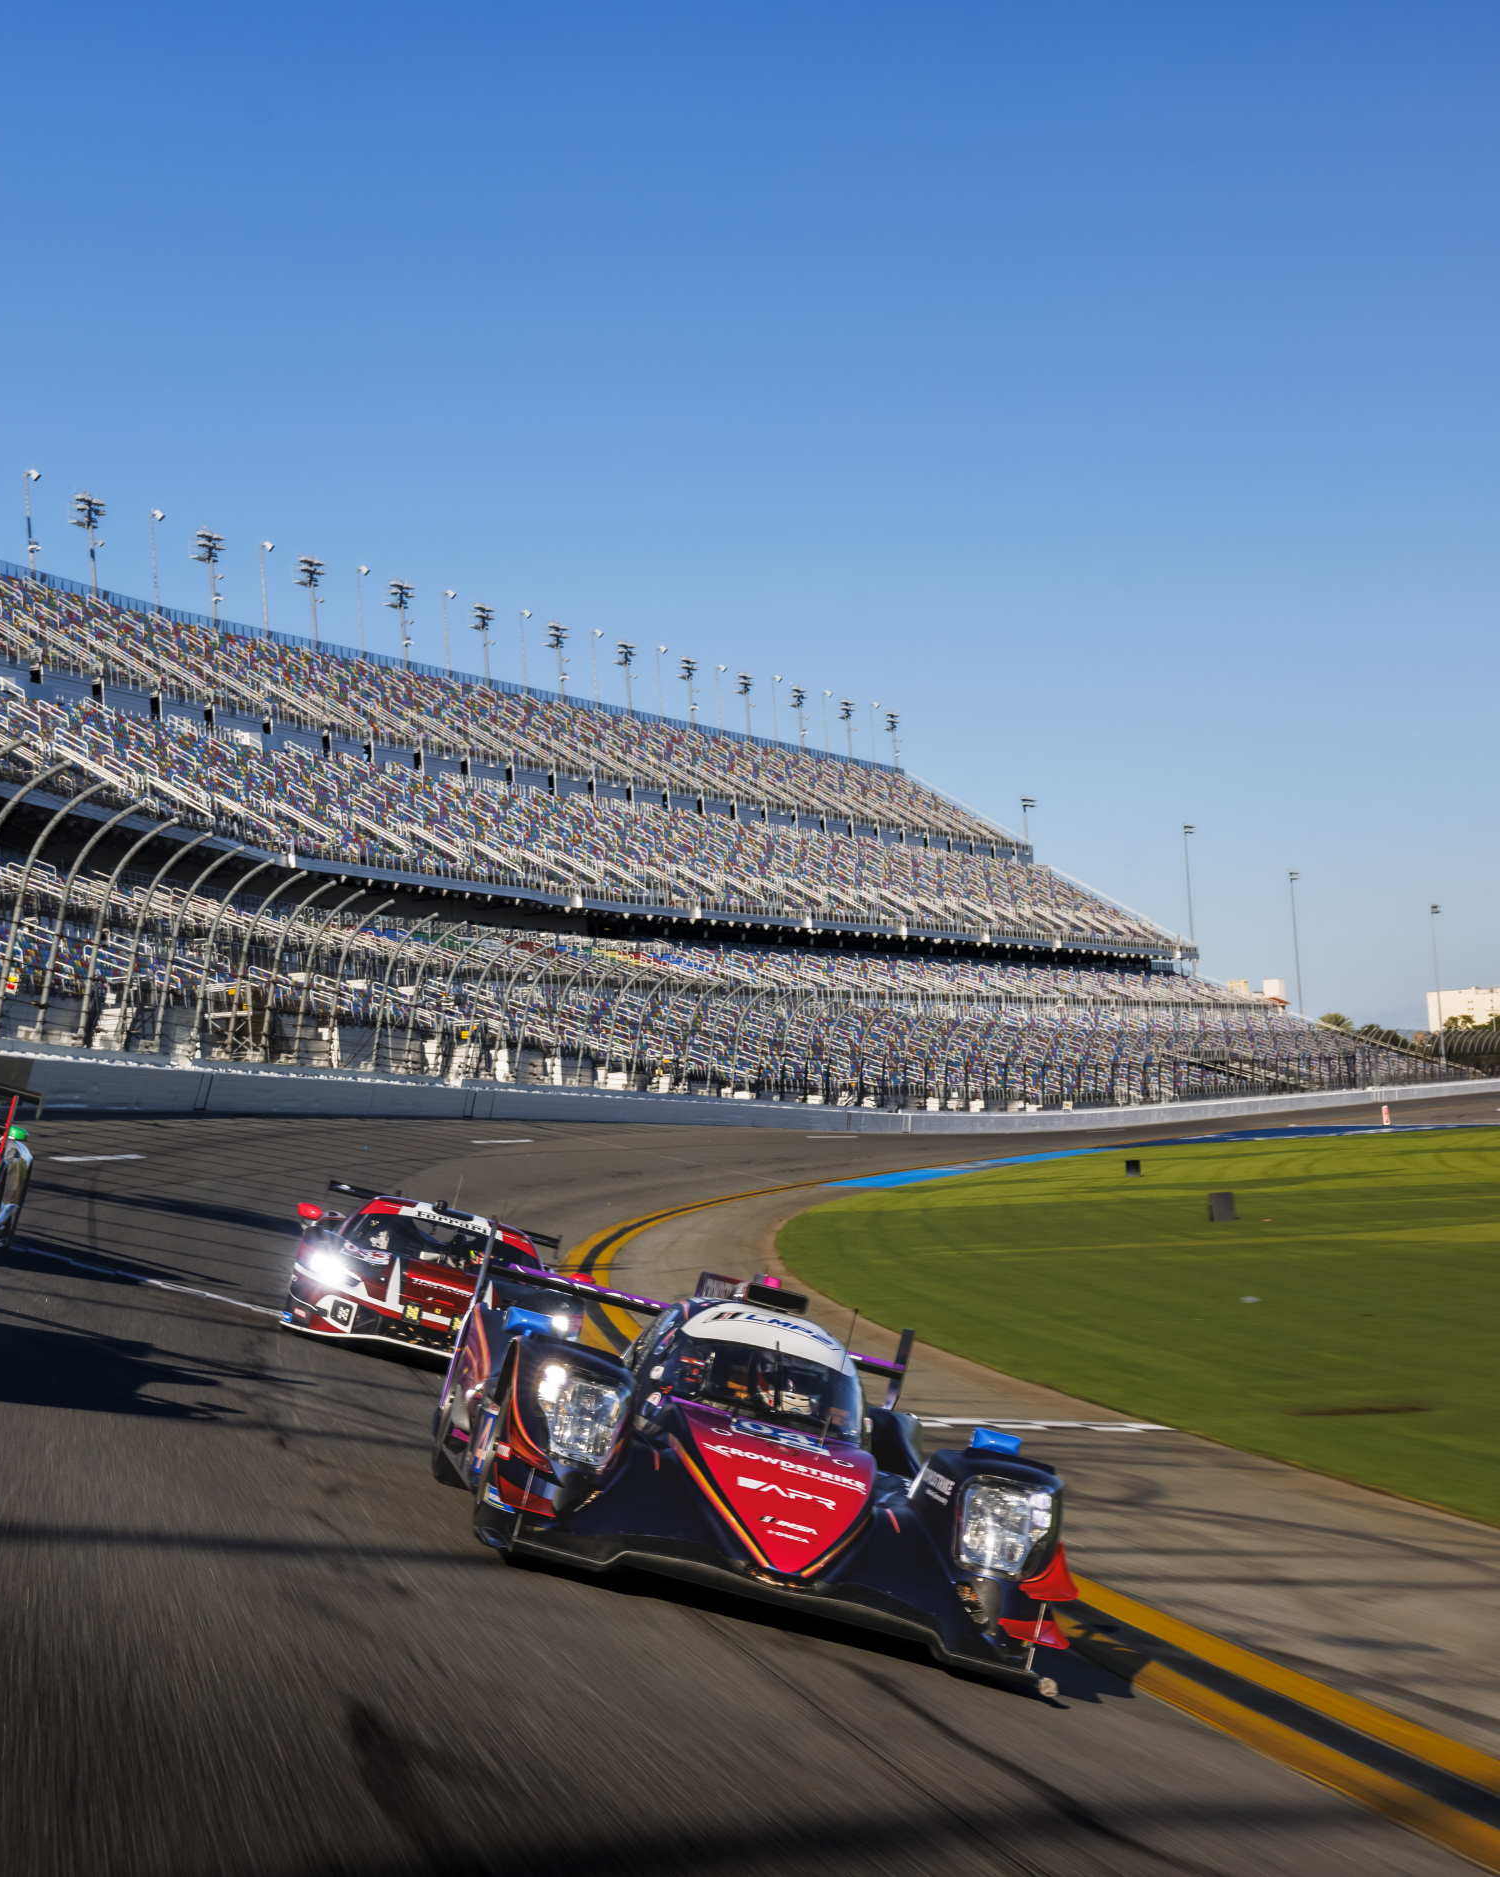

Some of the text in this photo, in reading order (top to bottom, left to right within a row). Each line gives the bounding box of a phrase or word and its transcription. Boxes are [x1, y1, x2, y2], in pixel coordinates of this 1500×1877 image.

[417, 1210, 488, 1235] Ferrari
[745, 1313, 833, 1346] LMP2
[740, 1420, 817, 1446] 04
[712, 1444, 867, 1492] CROWDSTRIKE
[760, 1484, 837, 1511] APR
[775, 1519, 819, 1535] IMSA
